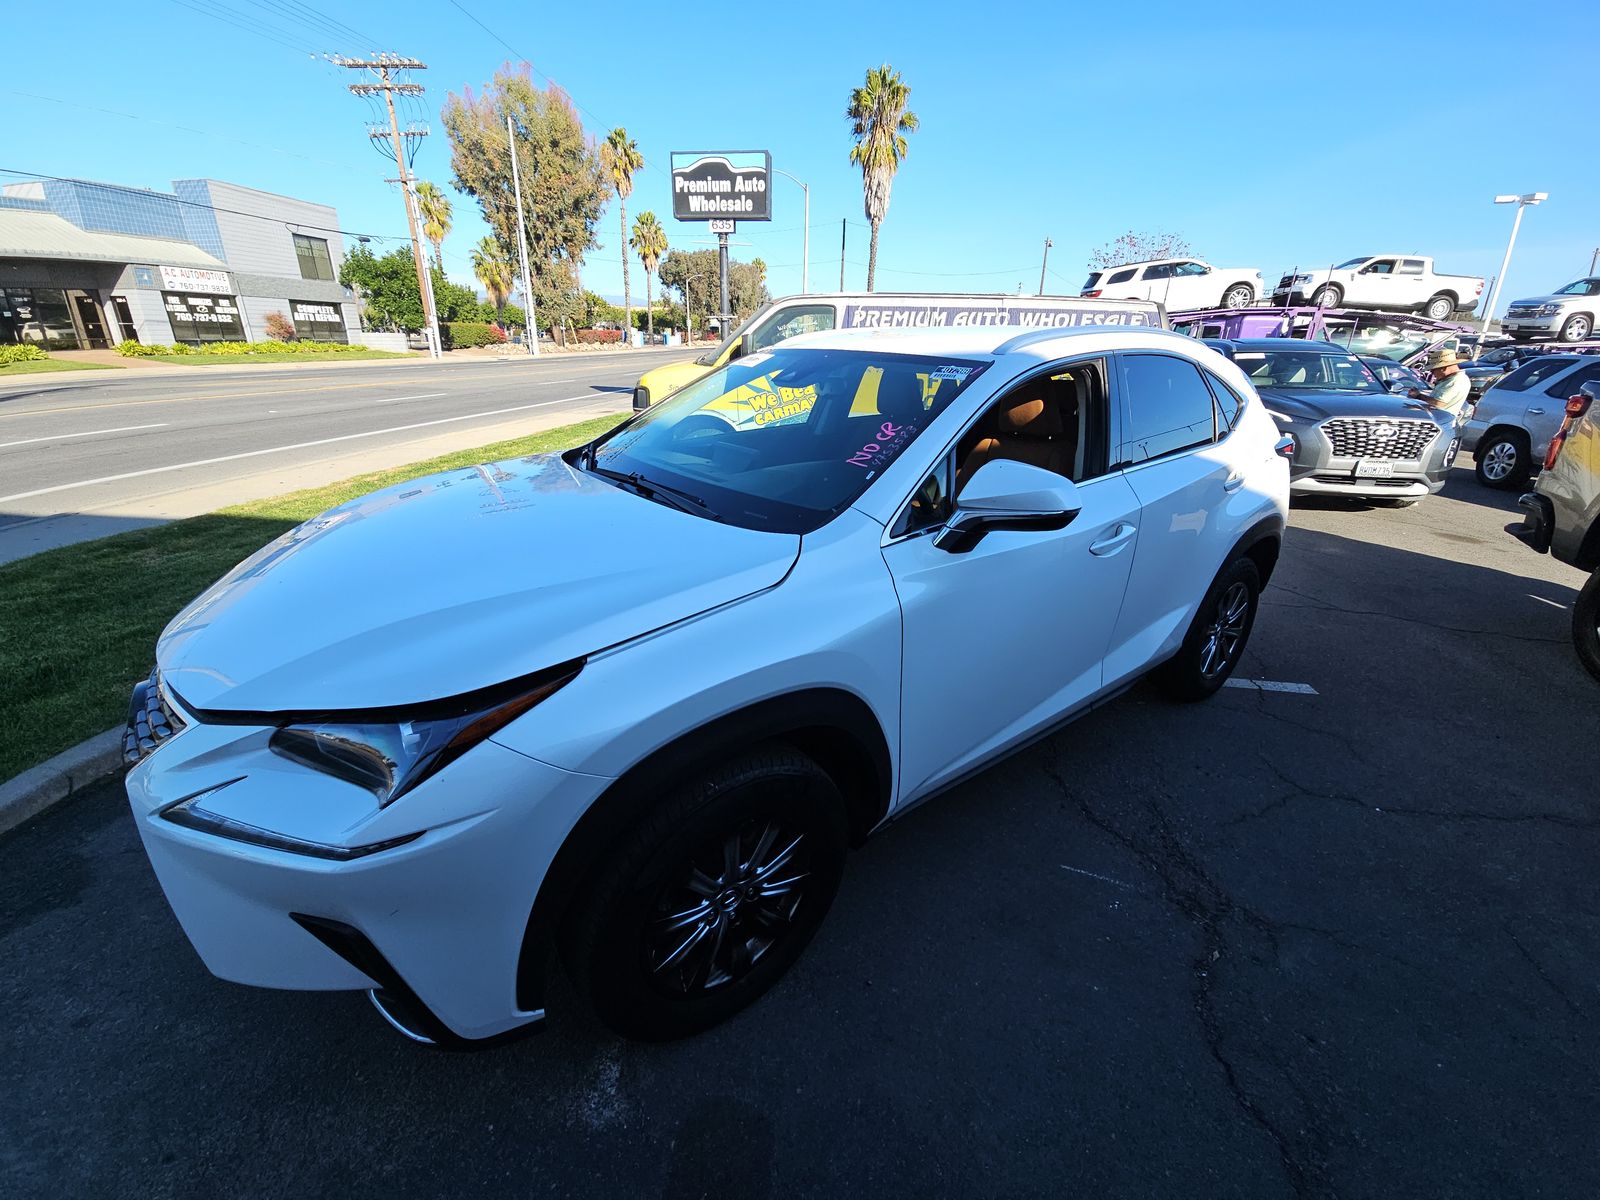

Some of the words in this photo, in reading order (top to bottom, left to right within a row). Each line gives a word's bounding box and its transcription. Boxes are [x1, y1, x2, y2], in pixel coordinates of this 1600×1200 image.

[675, 176, 731, 192] Premium
[735, 175, 766, 192] Auto
[688, 195, 753, 212] Wholesale
[711, 220, 732, 230] 635
[180, 269, 227, 281] AUTOMOTIVE
[852, 310, 947, 328] PREMIUM
[952, 311, 1008, 327] AUTO
[1019, 312, 1142, 328] WHOLESALE
[748, 393, 778, 412] We
[779, 384, 816, 403] Bea
[846, 443, 880, 467] NO
[876, 422, 903, 440] CR
